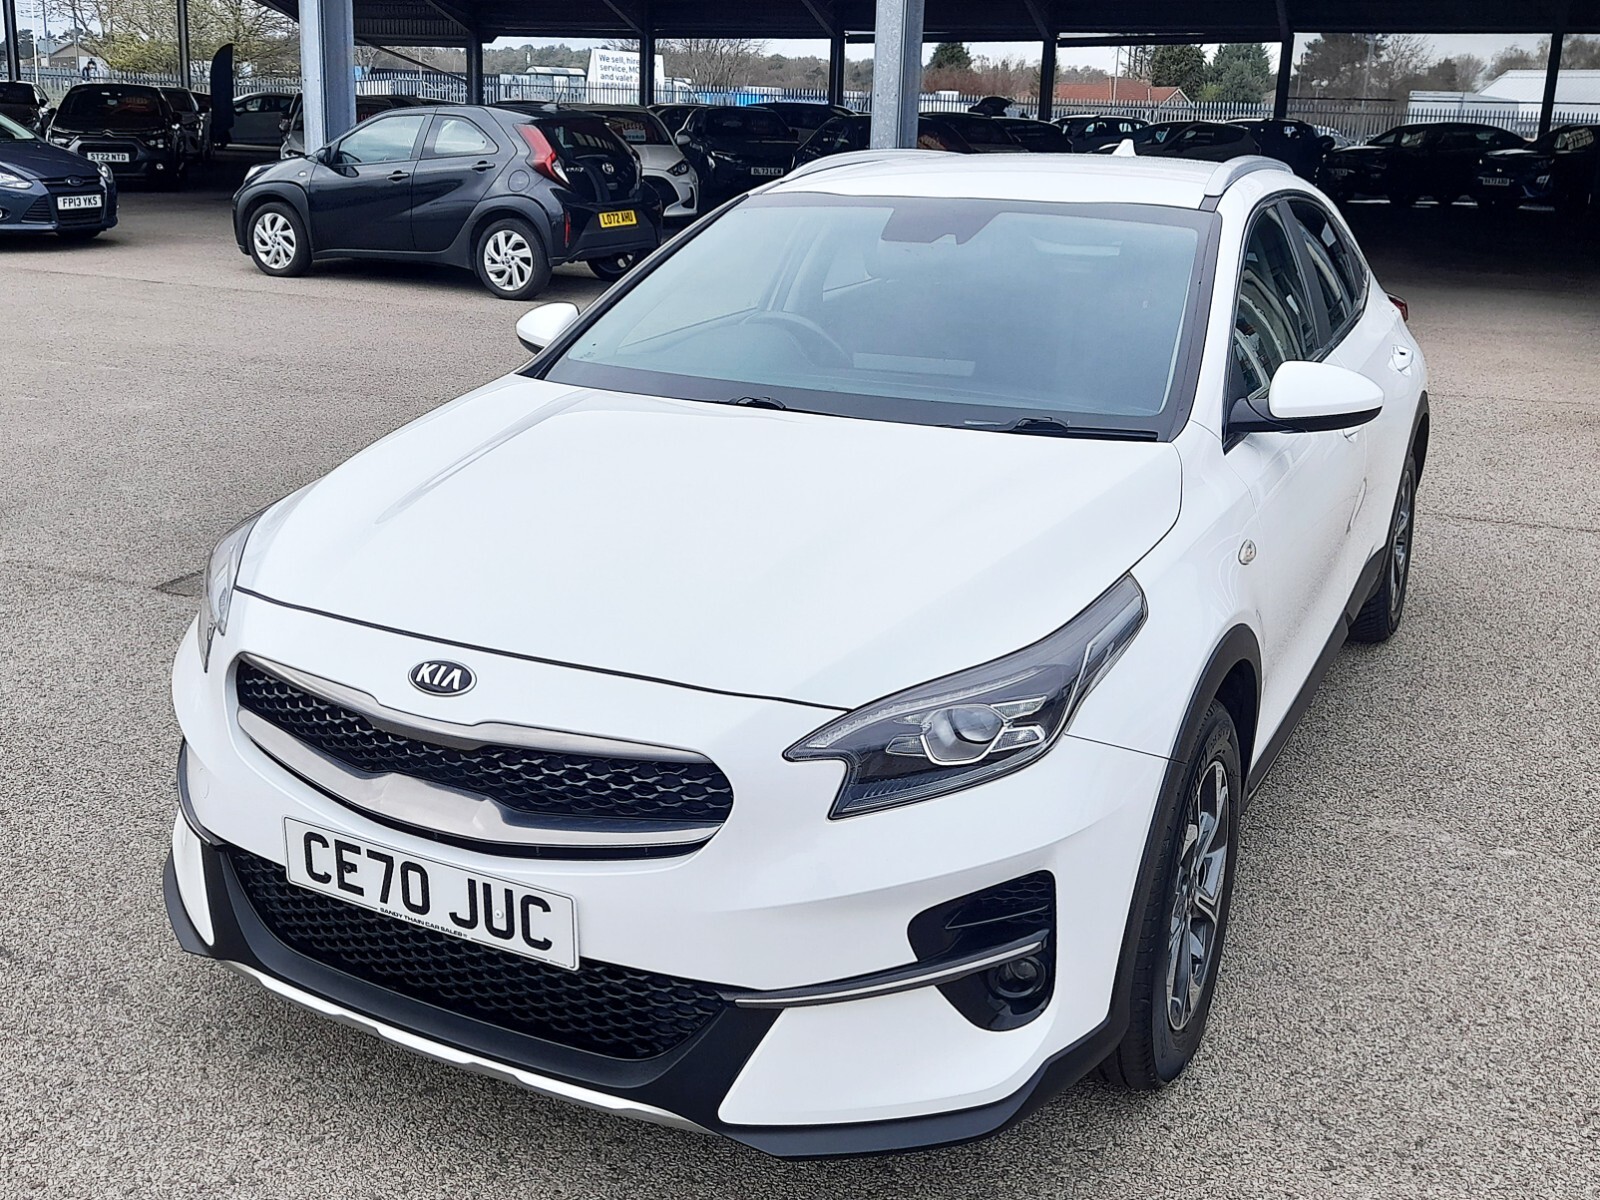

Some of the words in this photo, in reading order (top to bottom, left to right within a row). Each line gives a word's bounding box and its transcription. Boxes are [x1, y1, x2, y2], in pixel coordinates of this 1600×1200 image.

[599, 54, 610, 62] We
[90, 153, 110, 161] ST22
[62, 197, 82, 208] FP13
[83, 196, 98, 206] YKS
[415, 662, 463, 690] KIA
[303, 831, 431, 915] CE70
[449, 878, 553, 951] JUC
[380, 907, 403, 919] SANDY
[404, 914, 425, 925] THAIN
[425, 921, 440, 930] CAR
[440, 926, 463, 937] SALES
